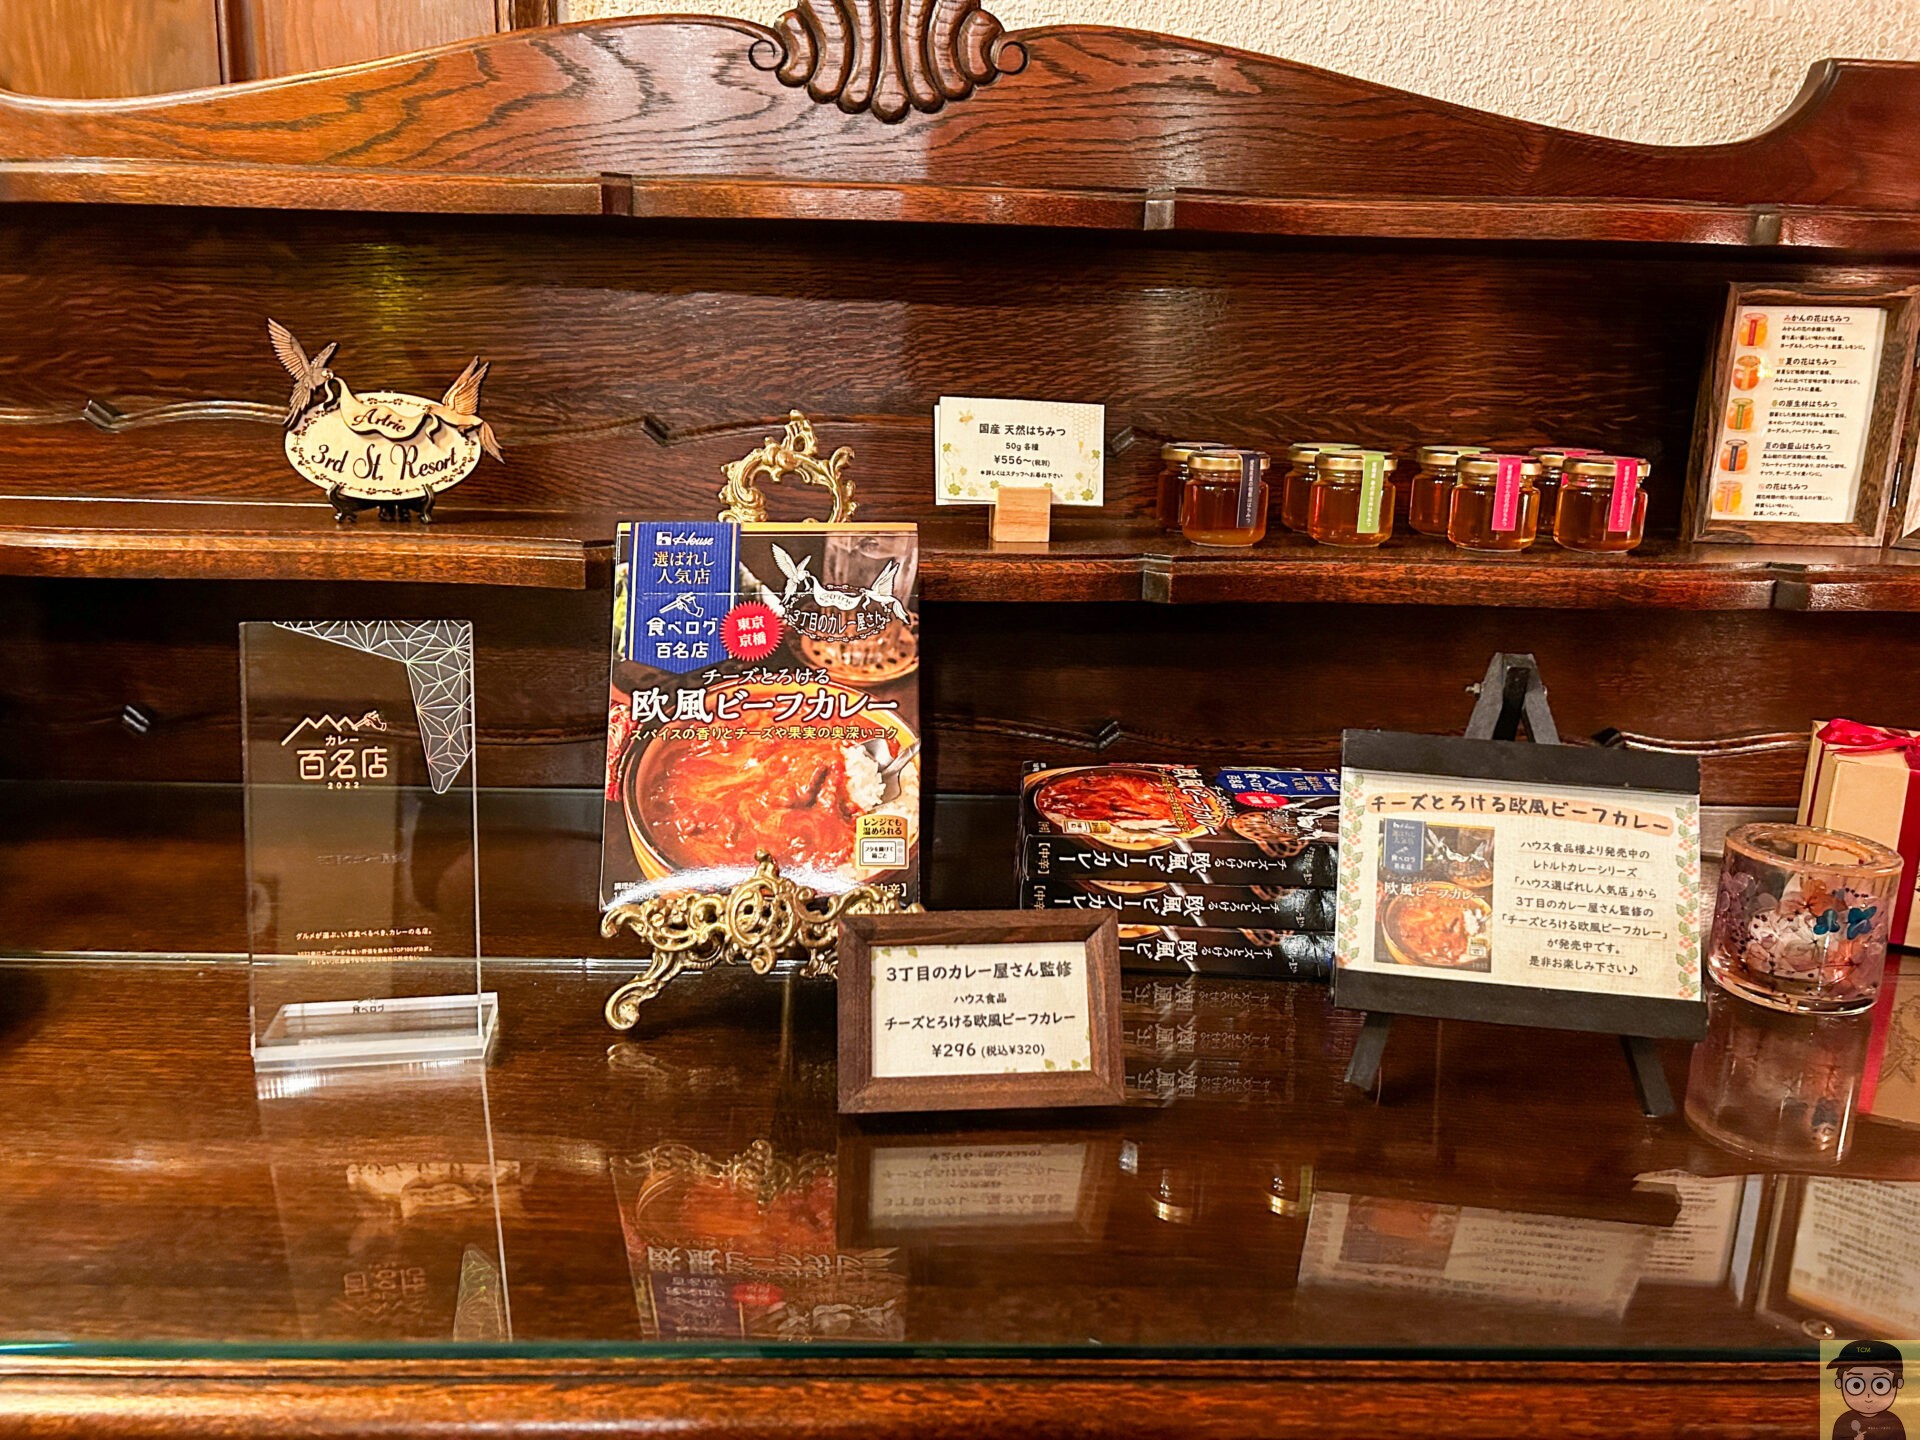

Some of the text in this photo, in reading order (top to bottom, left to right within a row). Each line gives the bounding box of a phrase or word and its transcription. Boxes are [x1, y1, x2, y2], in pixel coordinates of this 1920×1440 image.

[1784, 314, 1850, 322] みかんの花はちみつ
[979, 423, 1066, 436] 国産 天然はちみつ
[1005, 442, 1039, 451] 50g 各種
[311, 444, 458, 481] 3rd St. Resort
[672, 532, 714, 546] House
[652, 551, 716, 567] 選ばれし
[656, 568, 711, 584] 人気店
[646, 618, 718, 636] 食べログ
[737, 616, 765, 630] 東京
[790, 610, 885, 635] 3丁目のカレー屋さん
[739, 632, 767, 648] 京橋
[656, 641, 709, 659] 百名店
[702, 668, 830, 685] チーズとろける
[631, 687, 899, 724] 欧風ビーフカレー
[325, 734, 359, 747] カレー
[630, 726, 899, 741] スパイスの香りとチーズや果実の奥深いコク
[296, 745, 388, 780] 百名店
[327, 782, 360, 790] 2022
[1172, 768, 1218, 836] 欧風ビーフカレー
[1370, 795, 1668, 831] チーズとろける欧風ビーフカレー
[864, 818, 902, 827] レンジでも
[863, 827, 902, 835] 温められる
[1038, 842, 1050, 874] 【中辛】
[1520, 841, 1650, 859] ハウス食品様より発売中の
[1058, 851, 1211, 874] 欧風ビーフカレー
[1214, 858, 1286, 870] チーズとろける
[1533, 860, 1638, 877] レトルトカレーシリーズ
[1514, 876, 1657, 898] 「ハウス選ばれし人気店」から
[1054, 892, 1205, 917] 欧風ビーフカレー
[1208, 900, 1280, 914] チーズとろける
[1516, 896, 1654, 917] 3丁目のカレー屋さん監修の
[1502, 913, 1668, 939] 「チーズとろける欧風ビーフカレー」
[1201, 946, 1273, 959] チーズとろける
[1547, 938, 1620, 954] が発売中です。
[886, 961, 1072, 982] 3丁目のカレー屋さん監修
[953, 993, 1006, 1005] ハウス食品
[885, 1012, 1075, 1031] チーズとろける欧風ビーフカレー
[932, 1043, 1045, 1058] ¥296 (税込¥320)
